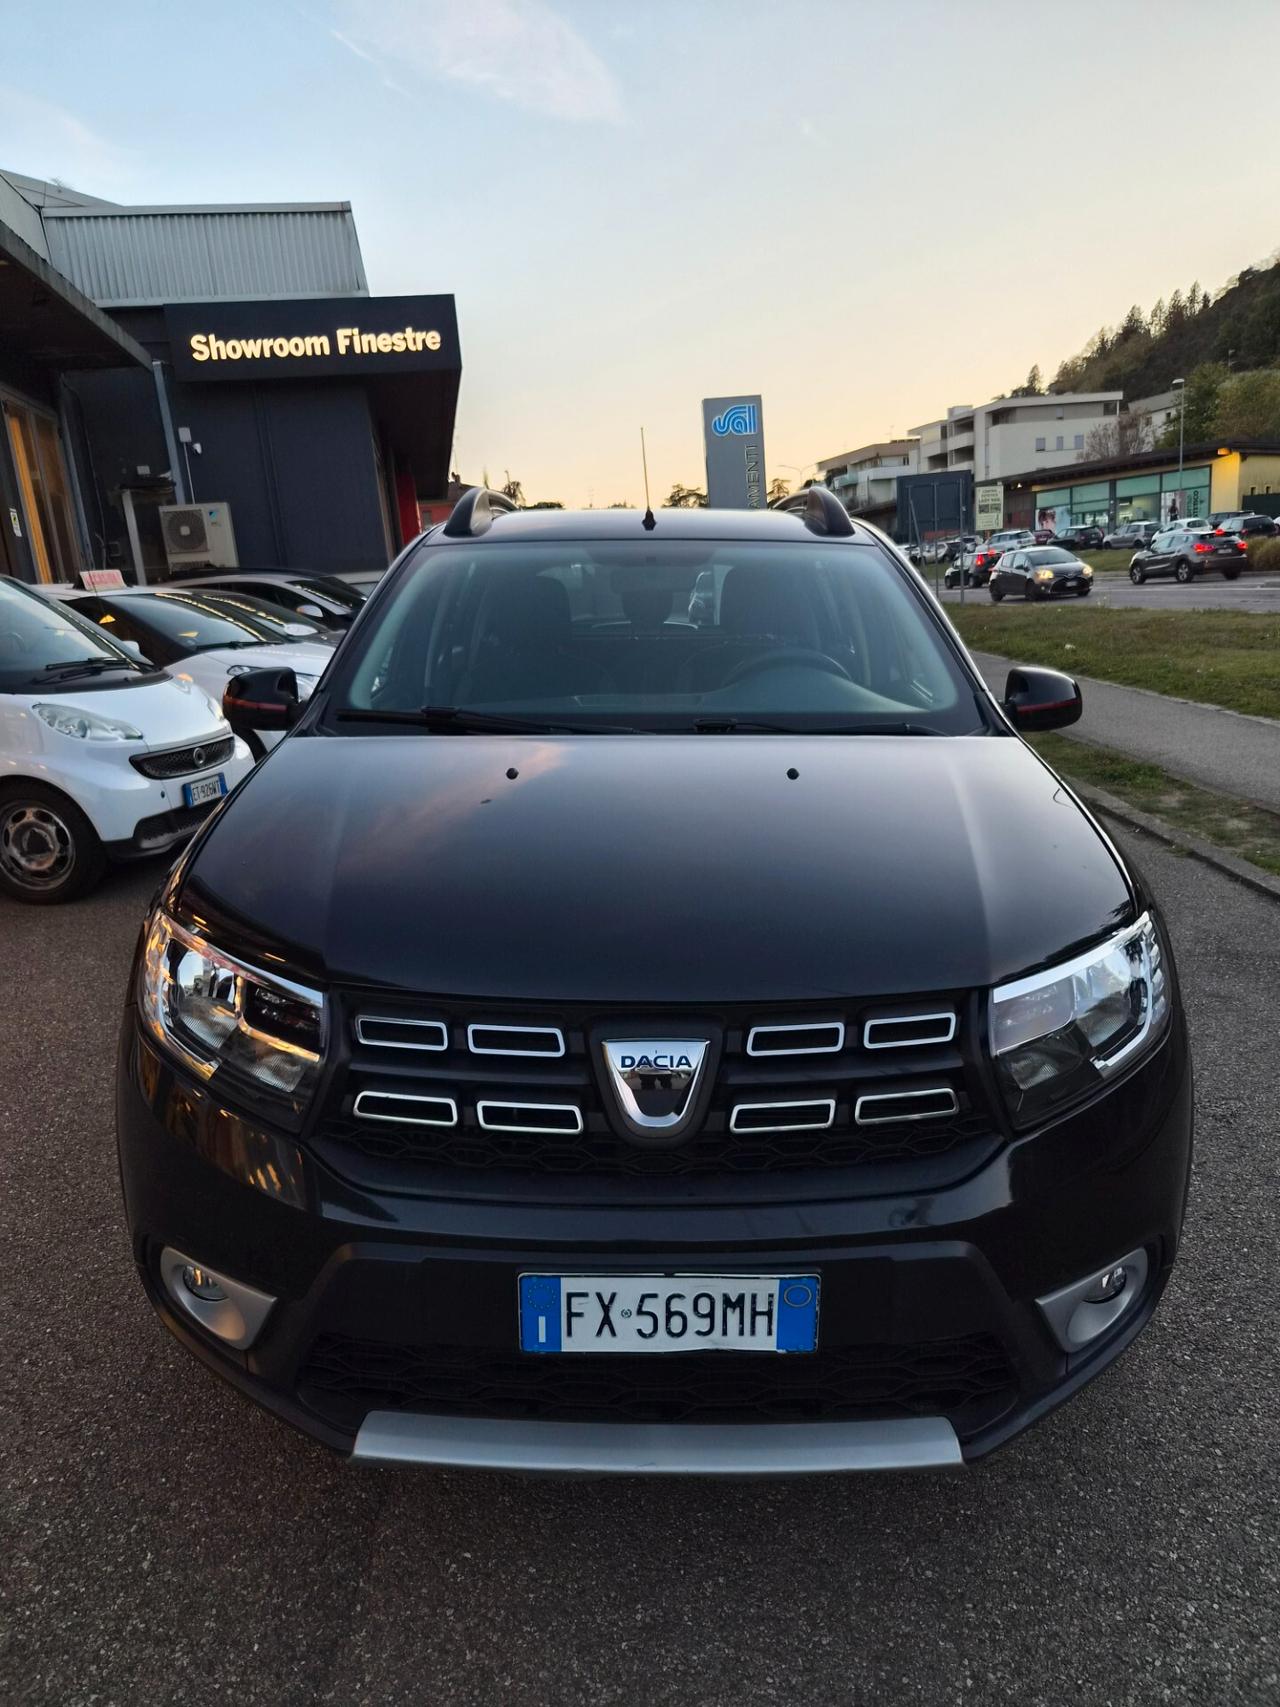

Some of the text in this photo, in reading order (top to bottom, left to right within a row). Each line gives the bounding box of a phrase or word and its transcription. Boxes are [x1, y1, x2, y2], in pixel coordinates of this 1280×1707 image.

[190, 326, 441, 361] Showroom Finestre
[620, 1055, 692, 1069] DACIA
